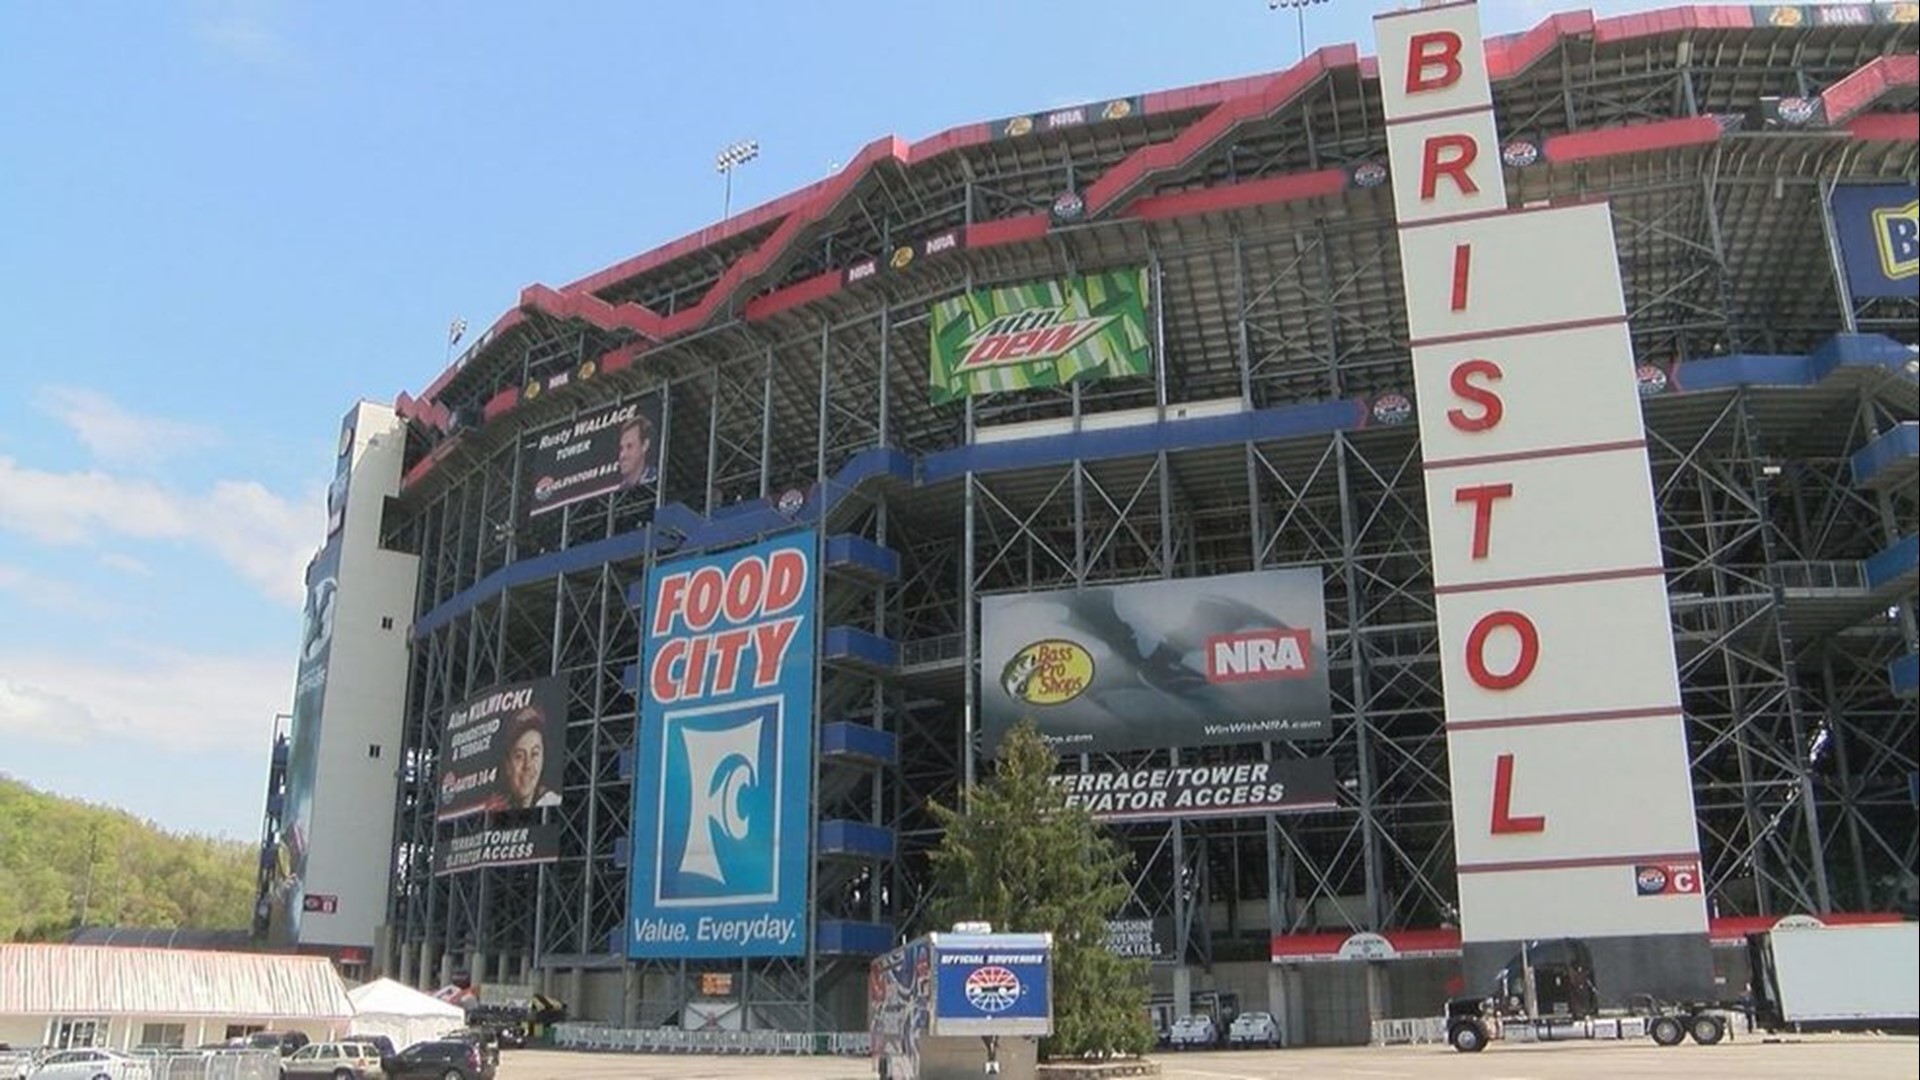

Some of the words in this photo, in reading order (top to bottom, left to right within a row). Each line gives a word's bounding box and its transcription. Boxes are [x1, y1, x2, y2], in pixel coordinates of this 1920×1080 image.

[1050, 109, 1083, 126] NRA
[926, 234, 955, 254] NRA
[849, 261, 876, 281] NRA
[539, 428, 572, 450] Rusty
[573, 404, 637, 436] WALLACE
[556, 439, 592, 461] TOWER
[652, 548, 807, 638] FOOD
[651, 615, 804, 704] CITY
[1038, 645, 1073, 661] Bass
[1214, 637, 1305, 675] NRA
[1039, 660, 1066, 678] Pro
[1039, 676, 1082, 697] Shops
[468, 687, 533, 723] KULWICKI
[1204, 719, 1322, 735] WinWithNRA.com
[1048, 763, 1270, 793] TERRACE/TOWER
[1175, 783, 1284, 808] ACCESS
[482, 842, 534, 861] ACCESS
[1674, 873, 1694, 892] C
[634, 917, 689, 942] Value.
[697, 914, 797, 947] Everyday.
